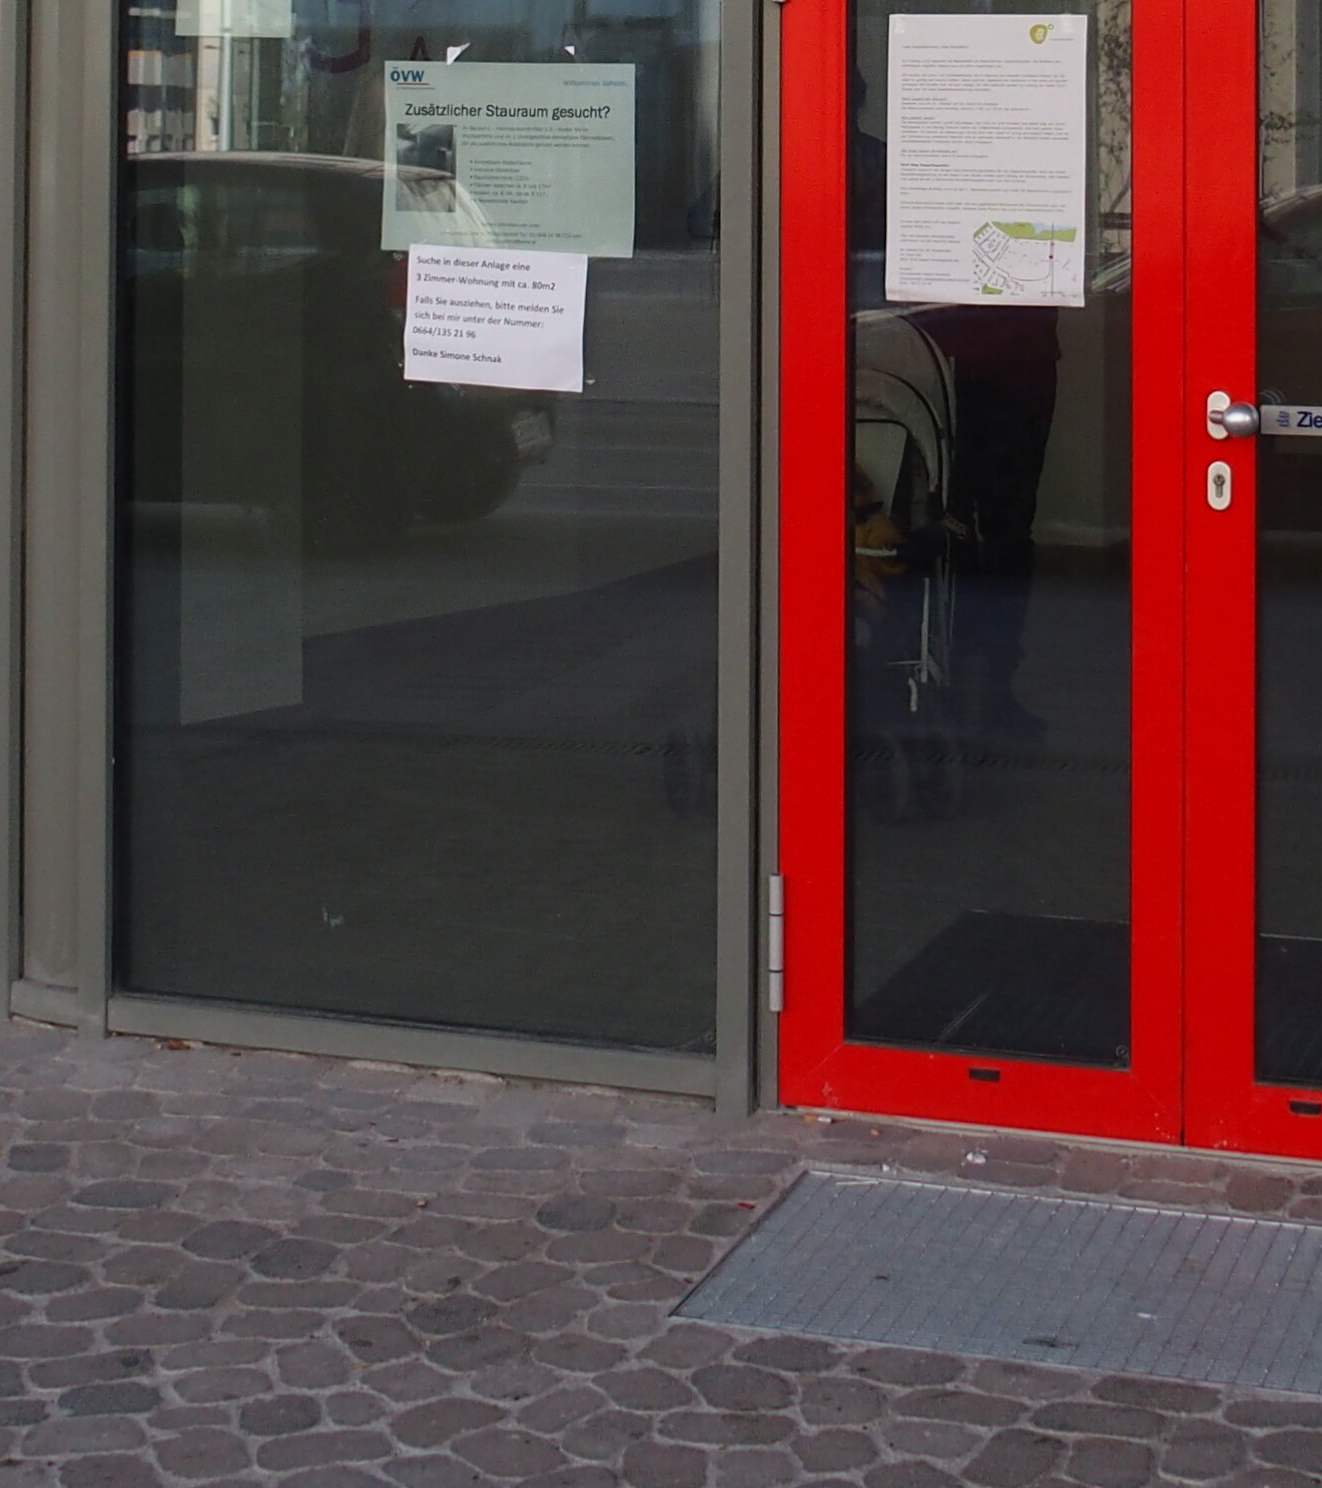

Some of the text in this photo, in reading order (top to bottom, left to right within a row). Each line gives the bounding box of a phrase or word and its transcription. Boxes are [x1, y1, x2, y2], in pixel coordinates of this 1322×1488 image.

[390, 67, 425, 83] ÖVW
[405, 103, 610, 121] Zusätzlicher Stauraum gesucht?
[417, 255, 531, 272] Suche in dieser Anlage eine
[501, 279, 515, 288] mit
[532, 280, 556, 291] 80m2
[415, 295, 565, 314] Falls Sie ausziehen, bitte melden Sie
[414, 311, 544, 329] sich bei mir unter der Nummer:
[453, 328, 464, 338] 21
[412, 348, 438, 359] Danke
[440, 350, 471, 361] Simone
